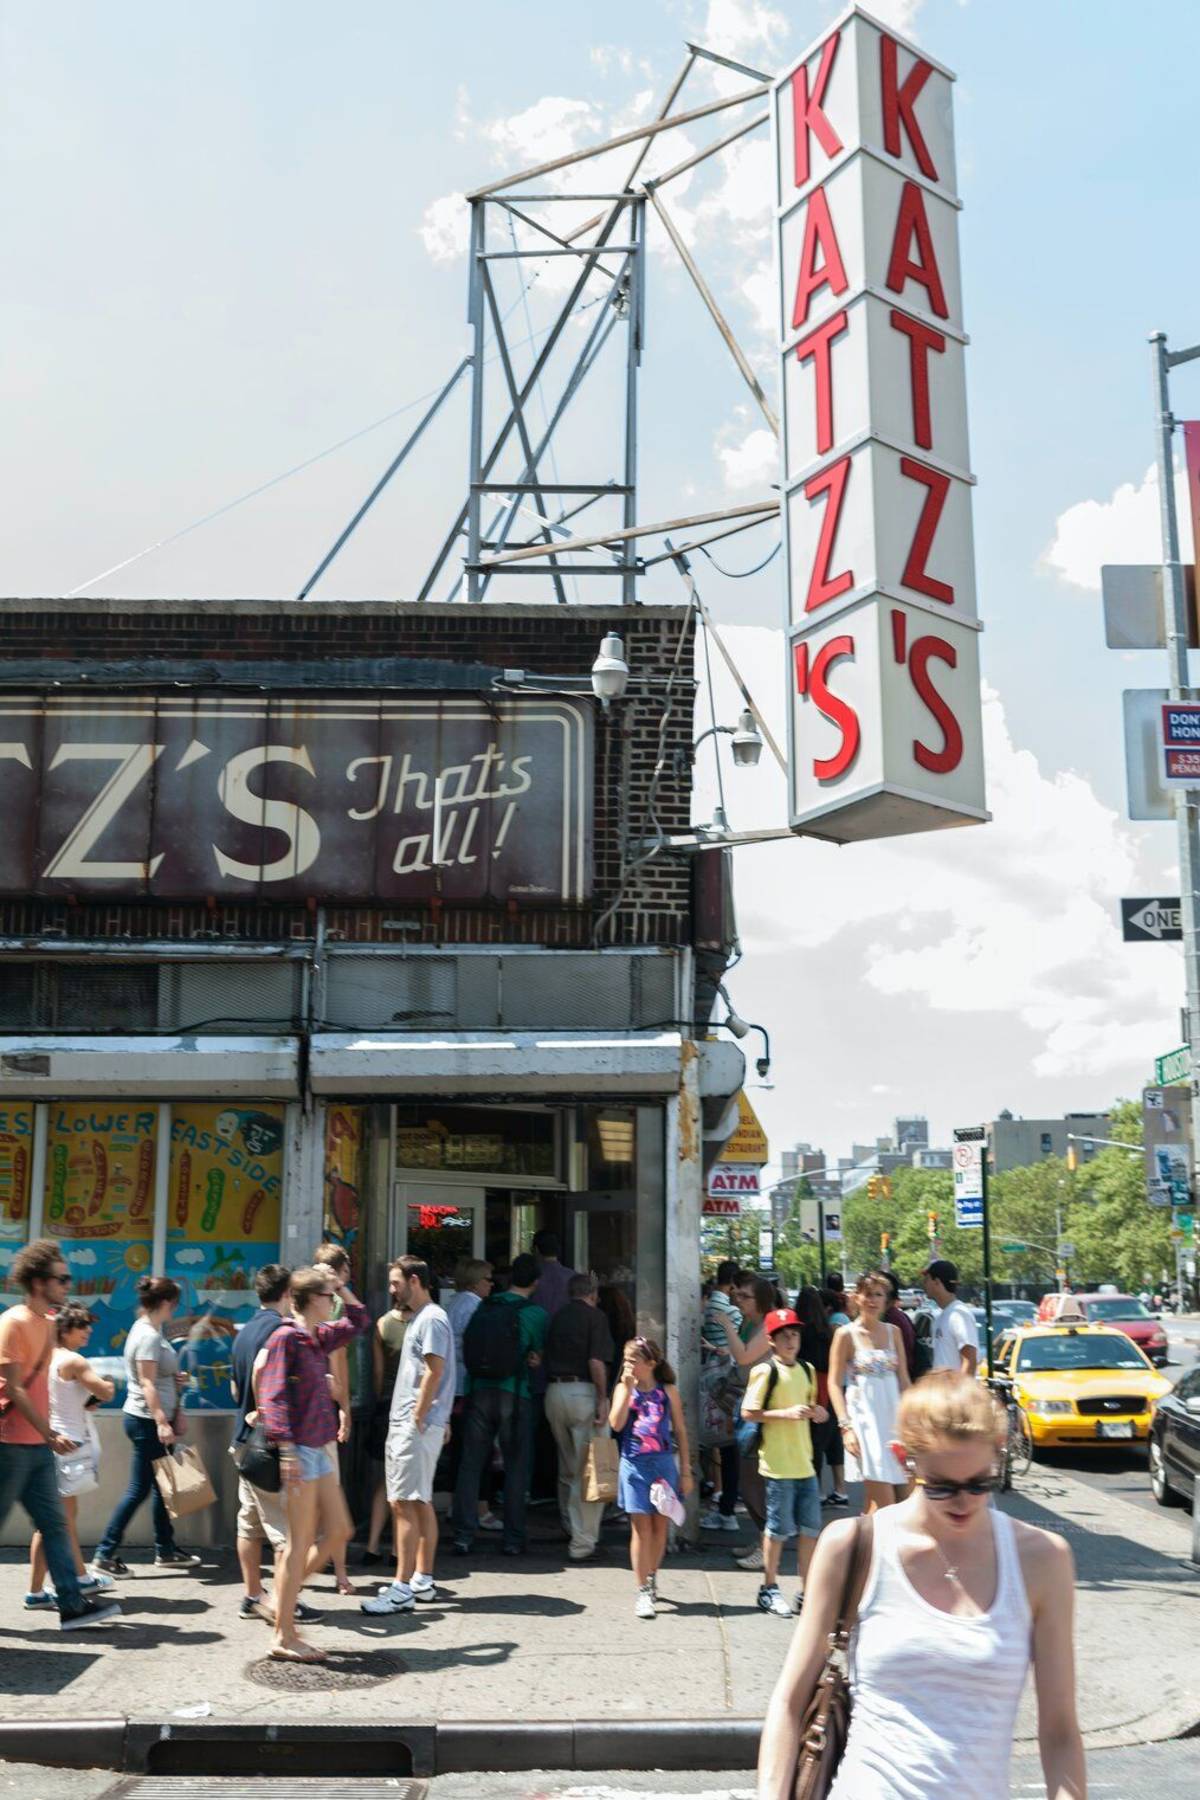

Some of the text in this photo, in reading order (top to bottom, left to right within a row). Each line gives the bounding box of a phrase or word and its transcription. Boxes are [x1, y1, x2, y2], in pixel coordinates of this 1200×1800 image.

[791, 30, 861, 781] KATZ'S
[880, 31, 963, 775] KATZ'S
[346, 742, 533, 821] That's
[1143, 910, 1182, 928] ONE
[55, 1110, 155, 1134] LOWER
[170, 1119, 231, 1155] EAST
[227, 1150, 283, 1196] SIDE
[711, 1174, 759, 1190] ATM
[702, 1200, 740, 1213] ATM
